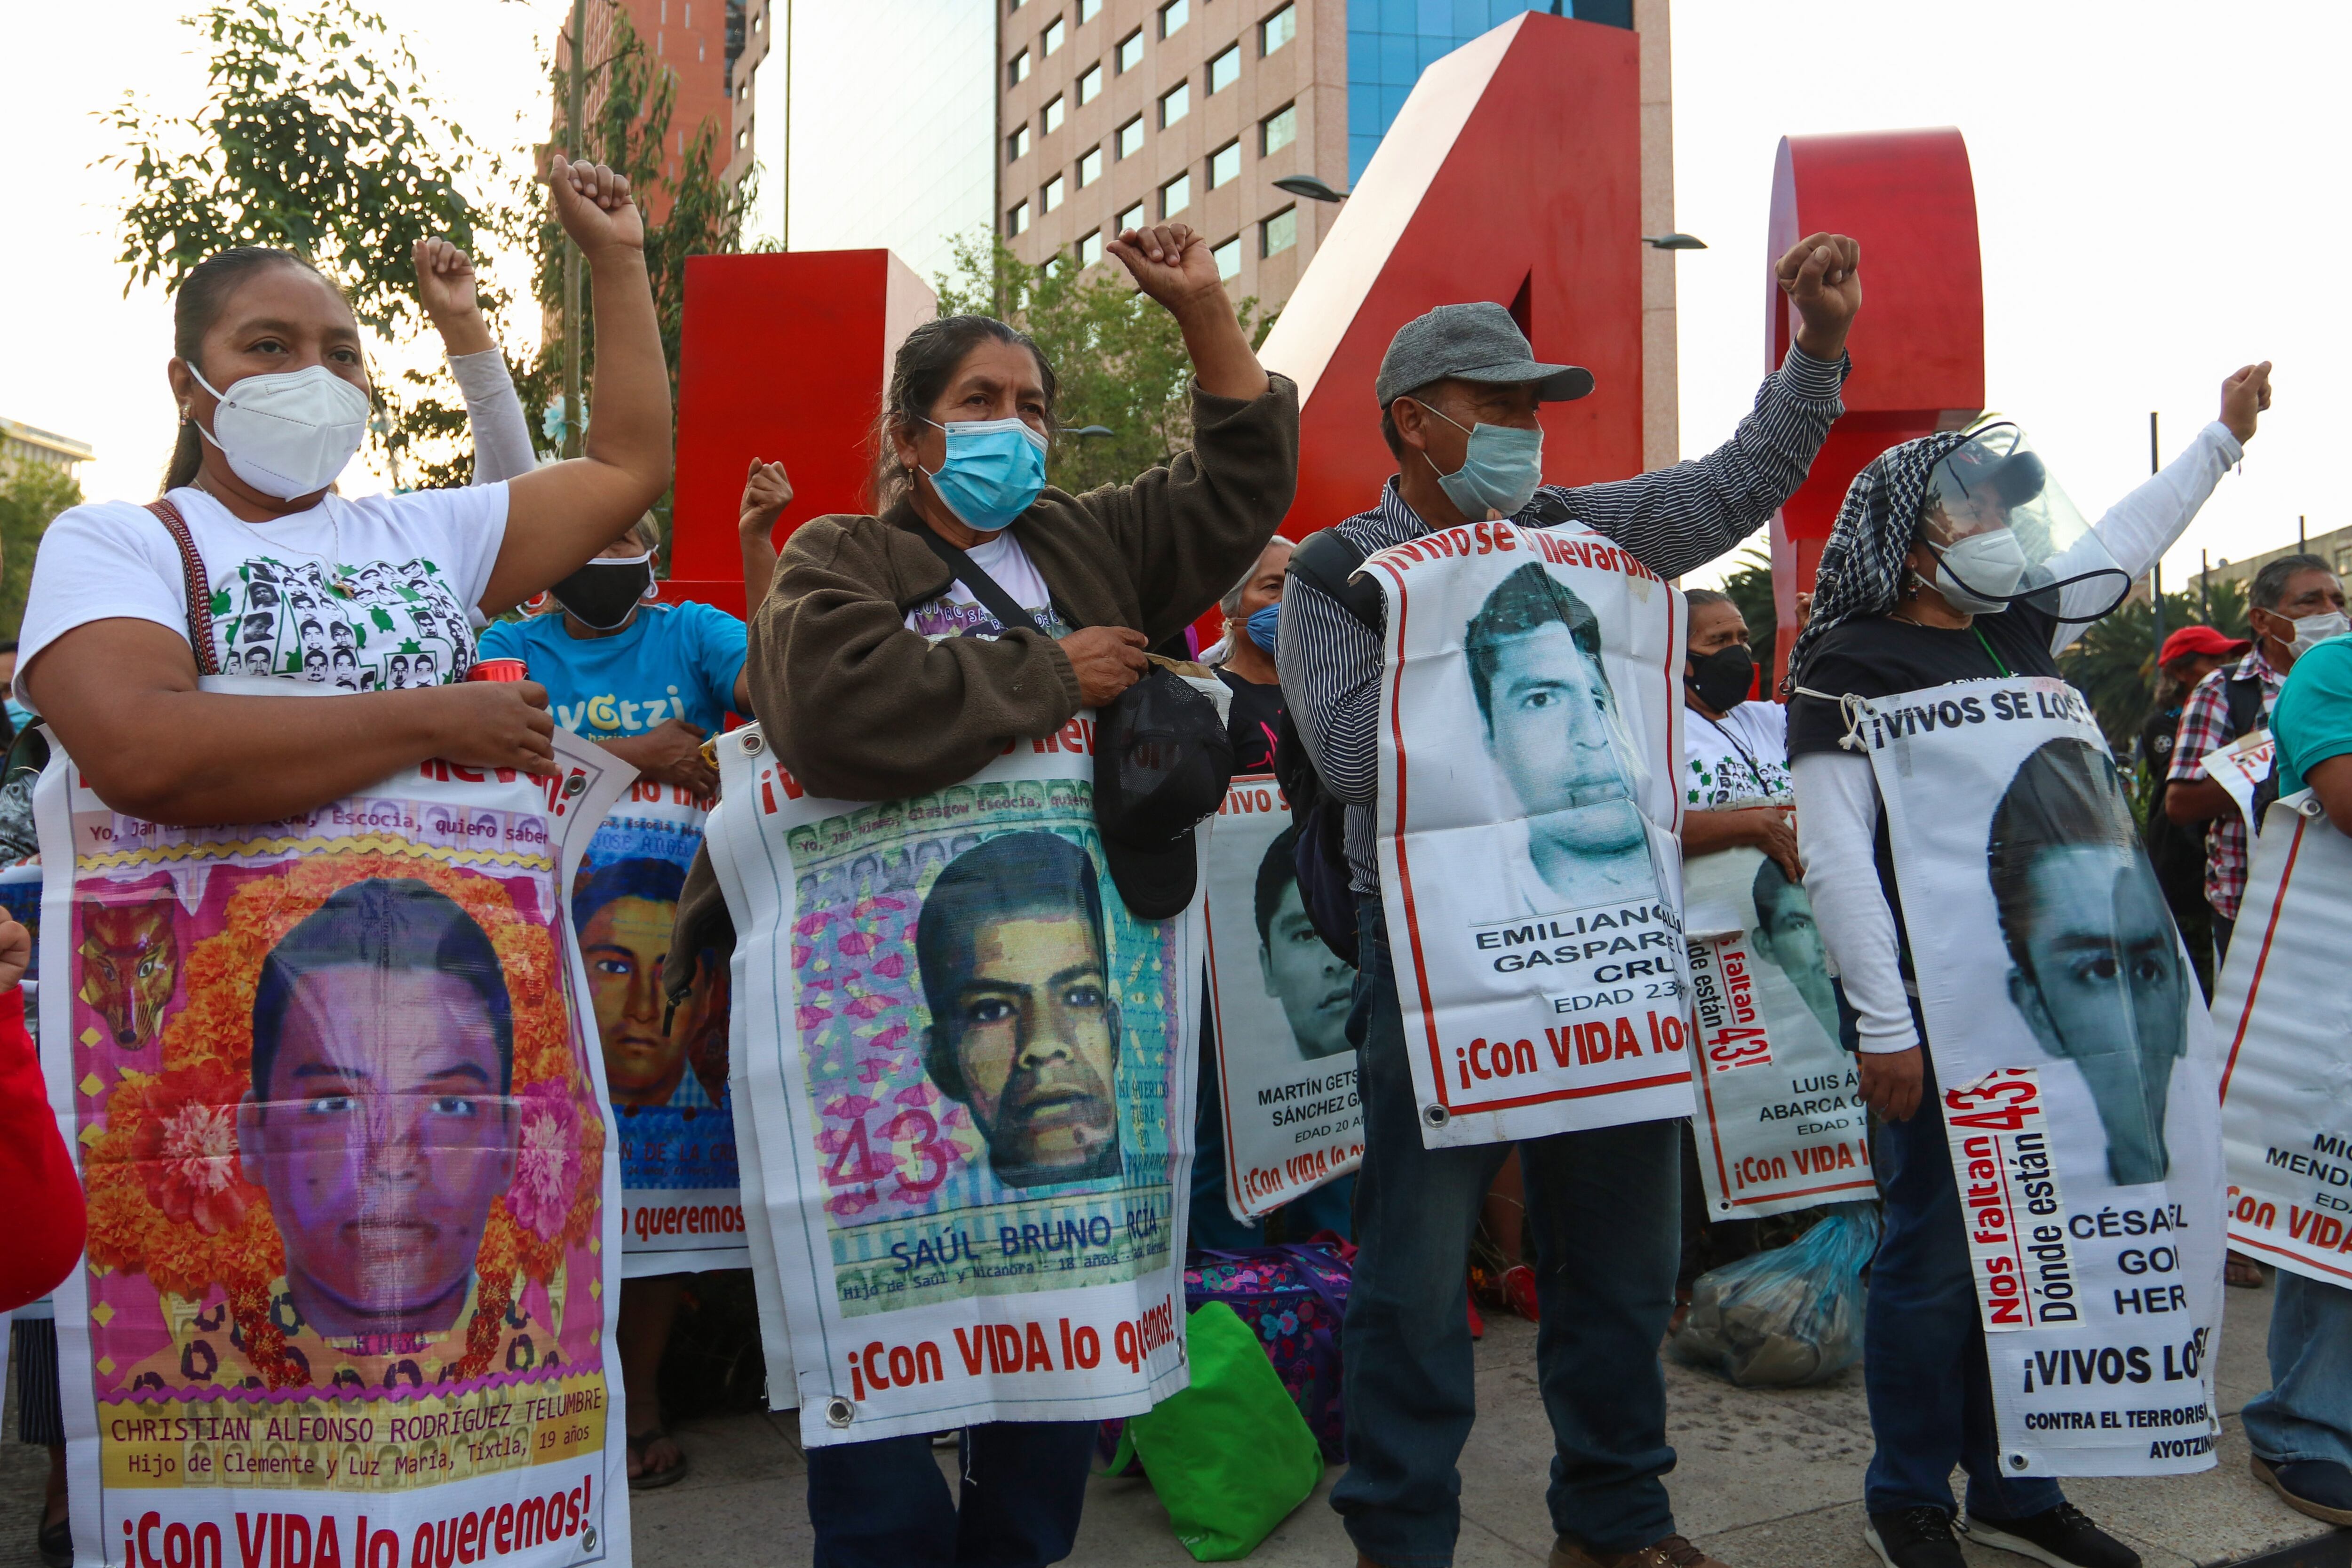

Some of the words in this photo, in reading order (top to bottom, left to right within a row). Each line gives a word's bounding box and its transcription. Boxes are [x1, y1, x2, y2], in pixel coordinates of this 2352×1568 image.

[1475, 523, 1517, 555] se
[548, 685, 685, 733] yotzi
[1873, 697, 1986, 748] ¡VIVOS
[1991, 692, 2033, 720] SE
[90, 826, 119, 843] Yo,
[132, 821, 157, 836] Jan
[332, 810, 422, 832] Escocia,
[436, 819, 496, 839] quiero
[505, 827, 548, 844] saber
[801, 841, 824, 853] Yo,
[832, 832, 852, 844] Jan
[908, 803, 969, 820] Glasgow
[977, 795, 1041, 811] Escocia,
[1494, 931, 1667, 973] GASPAR
[1594, 956, 1676, 984] CRU
[1555, 988, 1633, 1014] EDAD
[1645, 981, 1677, 1000] 23
[1696, 973, 1723, 1029] están
[1724, 951, 1756, 1024] faltan
[1456, 1037, 1538, 1090] ¡Con
[1545, 1017, 1642, 1068] VIDA
[1646, 1010, 1684, 1054] lo
[1707, 1027, 1772, 1072] 43!
[1258, 1078, 1321, 1106] MARTÍN
[1793, 1075, 1840, 1094] LUIS
[1272, 1096, 1344, 1126] SÁNCHEZ
[1295, 1126, 1331, 1143] EDAD
[1335, 1120, 1348, 1133] 20
[1760, 1097, 1847, 1122] ABARCA
[1797, 1119, 1849, 1135] EDAD
[1858, 1116, 1866, 1127] 1
[644, 1142, 666, 1162] DE
[680, 1144, 699, 1162] LA
[828, 1109, 947, 1202] 43
[1734, 1155, 1787, 1189] ¡Con
[1792, 1142, 1855, 1175] VIDA
[2009, 1133, 2058, 1216] están
[2266, 1147, 2352, 1188] MEND
[1244, 1167, 1285, 1204] ¡Con
[1286, 1149, 1328, 1186] VIDA
[1963, 1136, 2009, 1245] faltan
[635, 1205, 746, 1242] queremos
[890, 1227, 979, 1273] SAÚL
[1001, 1216, 1111, 1258] BRUNO
[2068, 1206, 2172, 1240] CÉSA
[843, 1284, 879, 1300] Hijo
[887, 1279, 906, 1293] de
[914, 1271, 948, 1288] Saúl
[957, 1273, 965, 1284] y
[974, 1263, 1034, 1279] Nicanora
[1058, 1258, 1075, 1270] 18
[1084, 1253, 1118, 1268] años
[2027, 1225, 2078, 1322] Dónde
[2118, 1245, 2180, 1274] GO
[1986, 1256, 2023, 1324] Nos
[848, 1341, 944, 1401] ¡Con
[953, 1322, 1053, 1376] VIDA
[1058, 1318, 1101, 1371] lo
[2024, 1346, 2152, 1393] ¡VIVOS
[111, 1417, 250, 1442] CHRISTIAN
[267, 1417, 373, 1442] ALFONSO
[390, 1404, 511, 1442] RODRÍGUEZ
[524, 1387, 602, 1425] TELUMBRE
[2026, 1411, 2095, 1430] CONTRA
[2101, 1411, 2122, 1429] EL
[2126, 1402, 2208, 1428] TERRORIS
[128, 1454, 175, 1474] Hijo
[188, 1454, 211, 1472] de
[223, 1454, 314, 1474] Clemente
[327, 1460, 338, 1479] y
[349, 1456, 380, 1476] Luz
[395, 1450, 455, 1476] María,
[468, 1435, 527, 1465] Tixtla,
[539, 1432, 556, 1449] 19
[564, 1425, 590, 1445] años
[2150, 1432, 2214, 1459] AYOTZIN
[123, 1511, 222, 1568] ¡Con
[235, 1512, 342, 1568] VIDA
[355, 1515, 400, 1568] lo
[412, 1474, 593, 1568] queremos!
